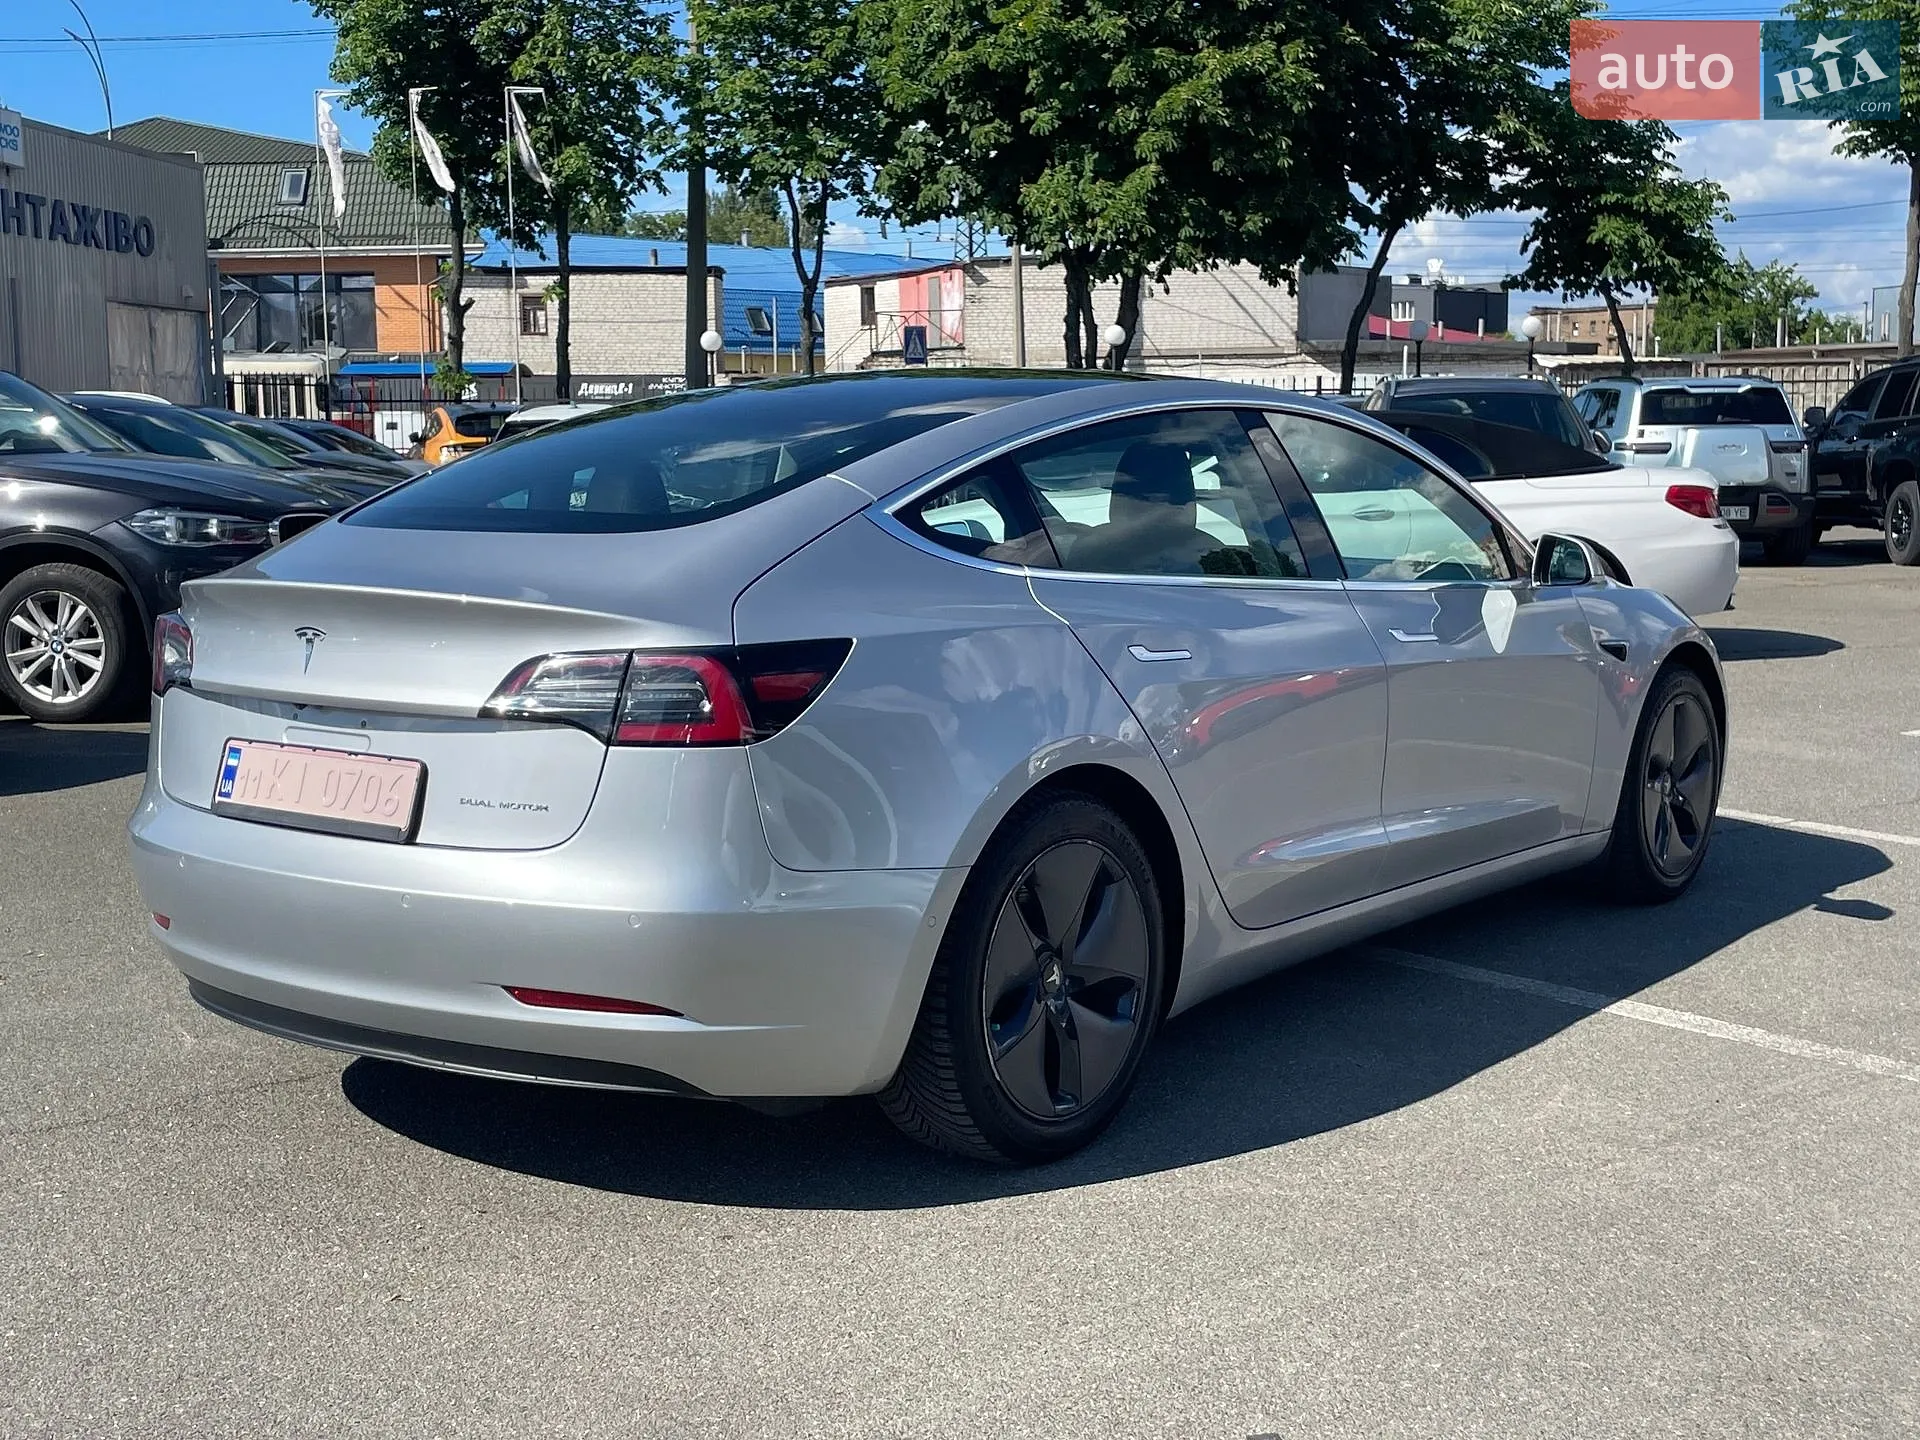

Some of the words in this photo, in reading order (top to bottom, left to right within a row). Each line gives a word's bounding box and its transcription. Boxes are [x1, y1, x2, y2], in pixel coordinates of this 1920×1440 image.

[1734, 507, 1747, 518] YE
[221, 780, 233, 794] UA
[321, 767, 404, 817] 0706
[460, 797, 495, 809] DUAL
[499, 801, 550, 812] MOTOR
